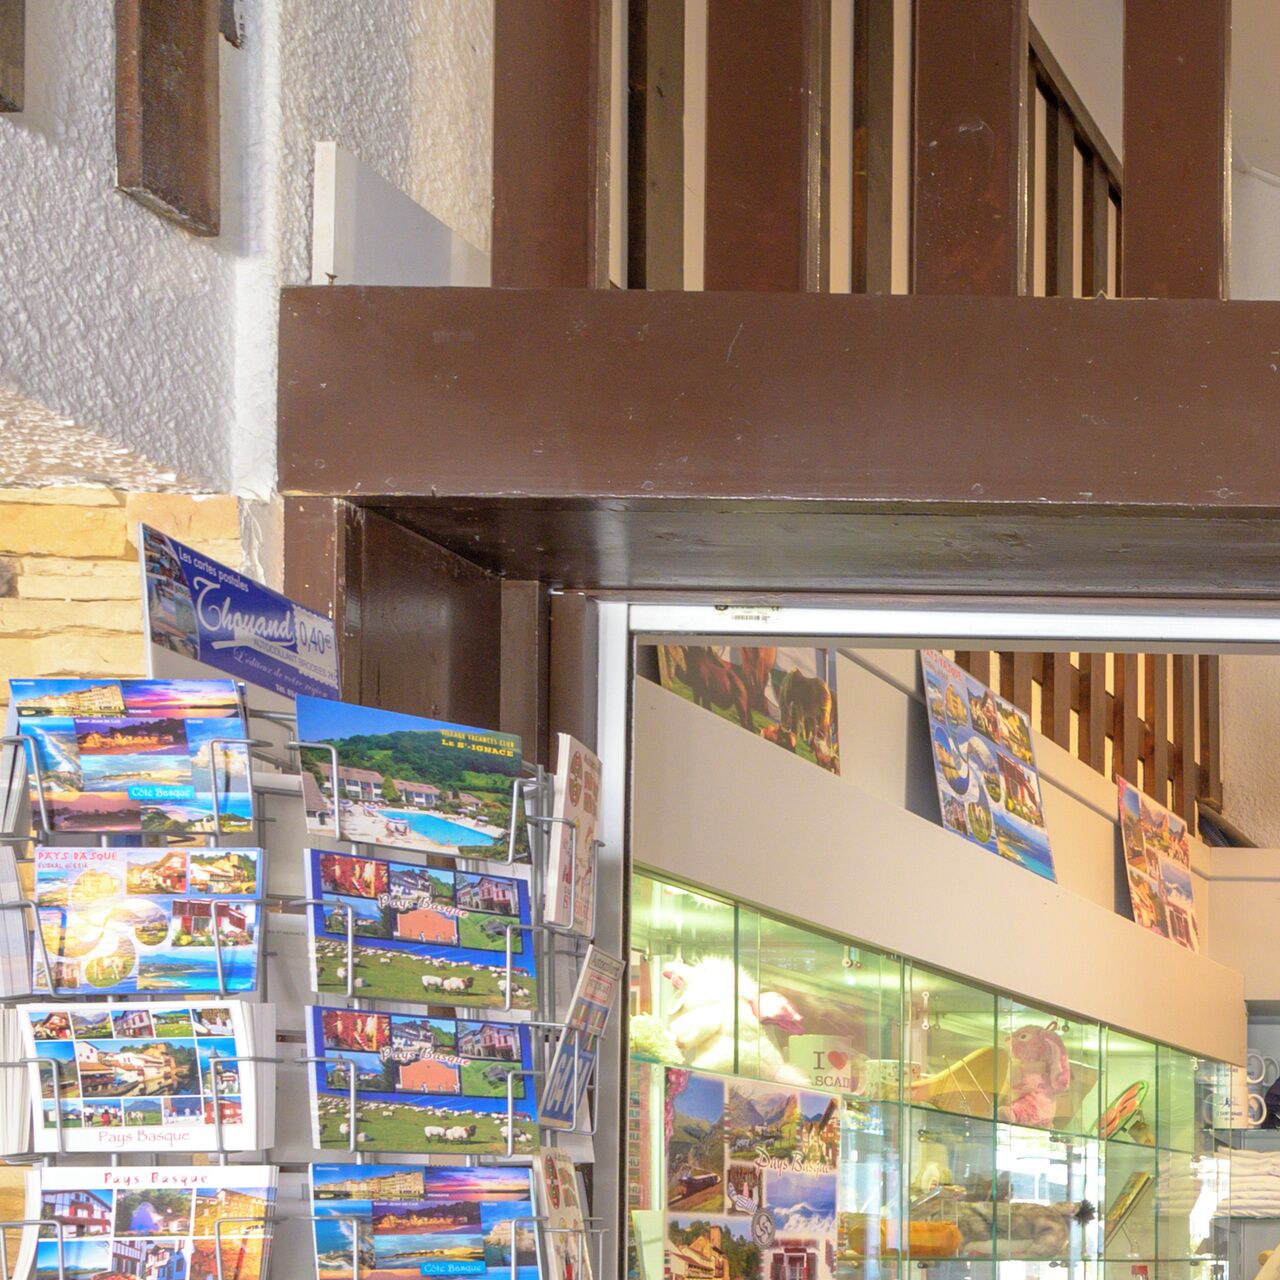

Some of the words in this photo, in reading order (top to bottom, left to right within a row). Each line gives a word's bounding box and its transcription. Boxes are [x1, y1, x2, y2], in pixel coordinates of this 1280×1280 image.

[178, 547, 192, 564] Les
[193, 557, 217, 577] cartes
[218, 571, 249, 592] postales
[417, 896, 469, 919] Basque
[420, 1049, 471, 1067] Basque
[813, 1051, 825, 1070] I
[98, 1131, 133, 1149] Pays
[137, 1130, 190, 1147] Basque
[103, 1172, 140, 1185] Pays
[151, 1172, 208, 1186] Basque
